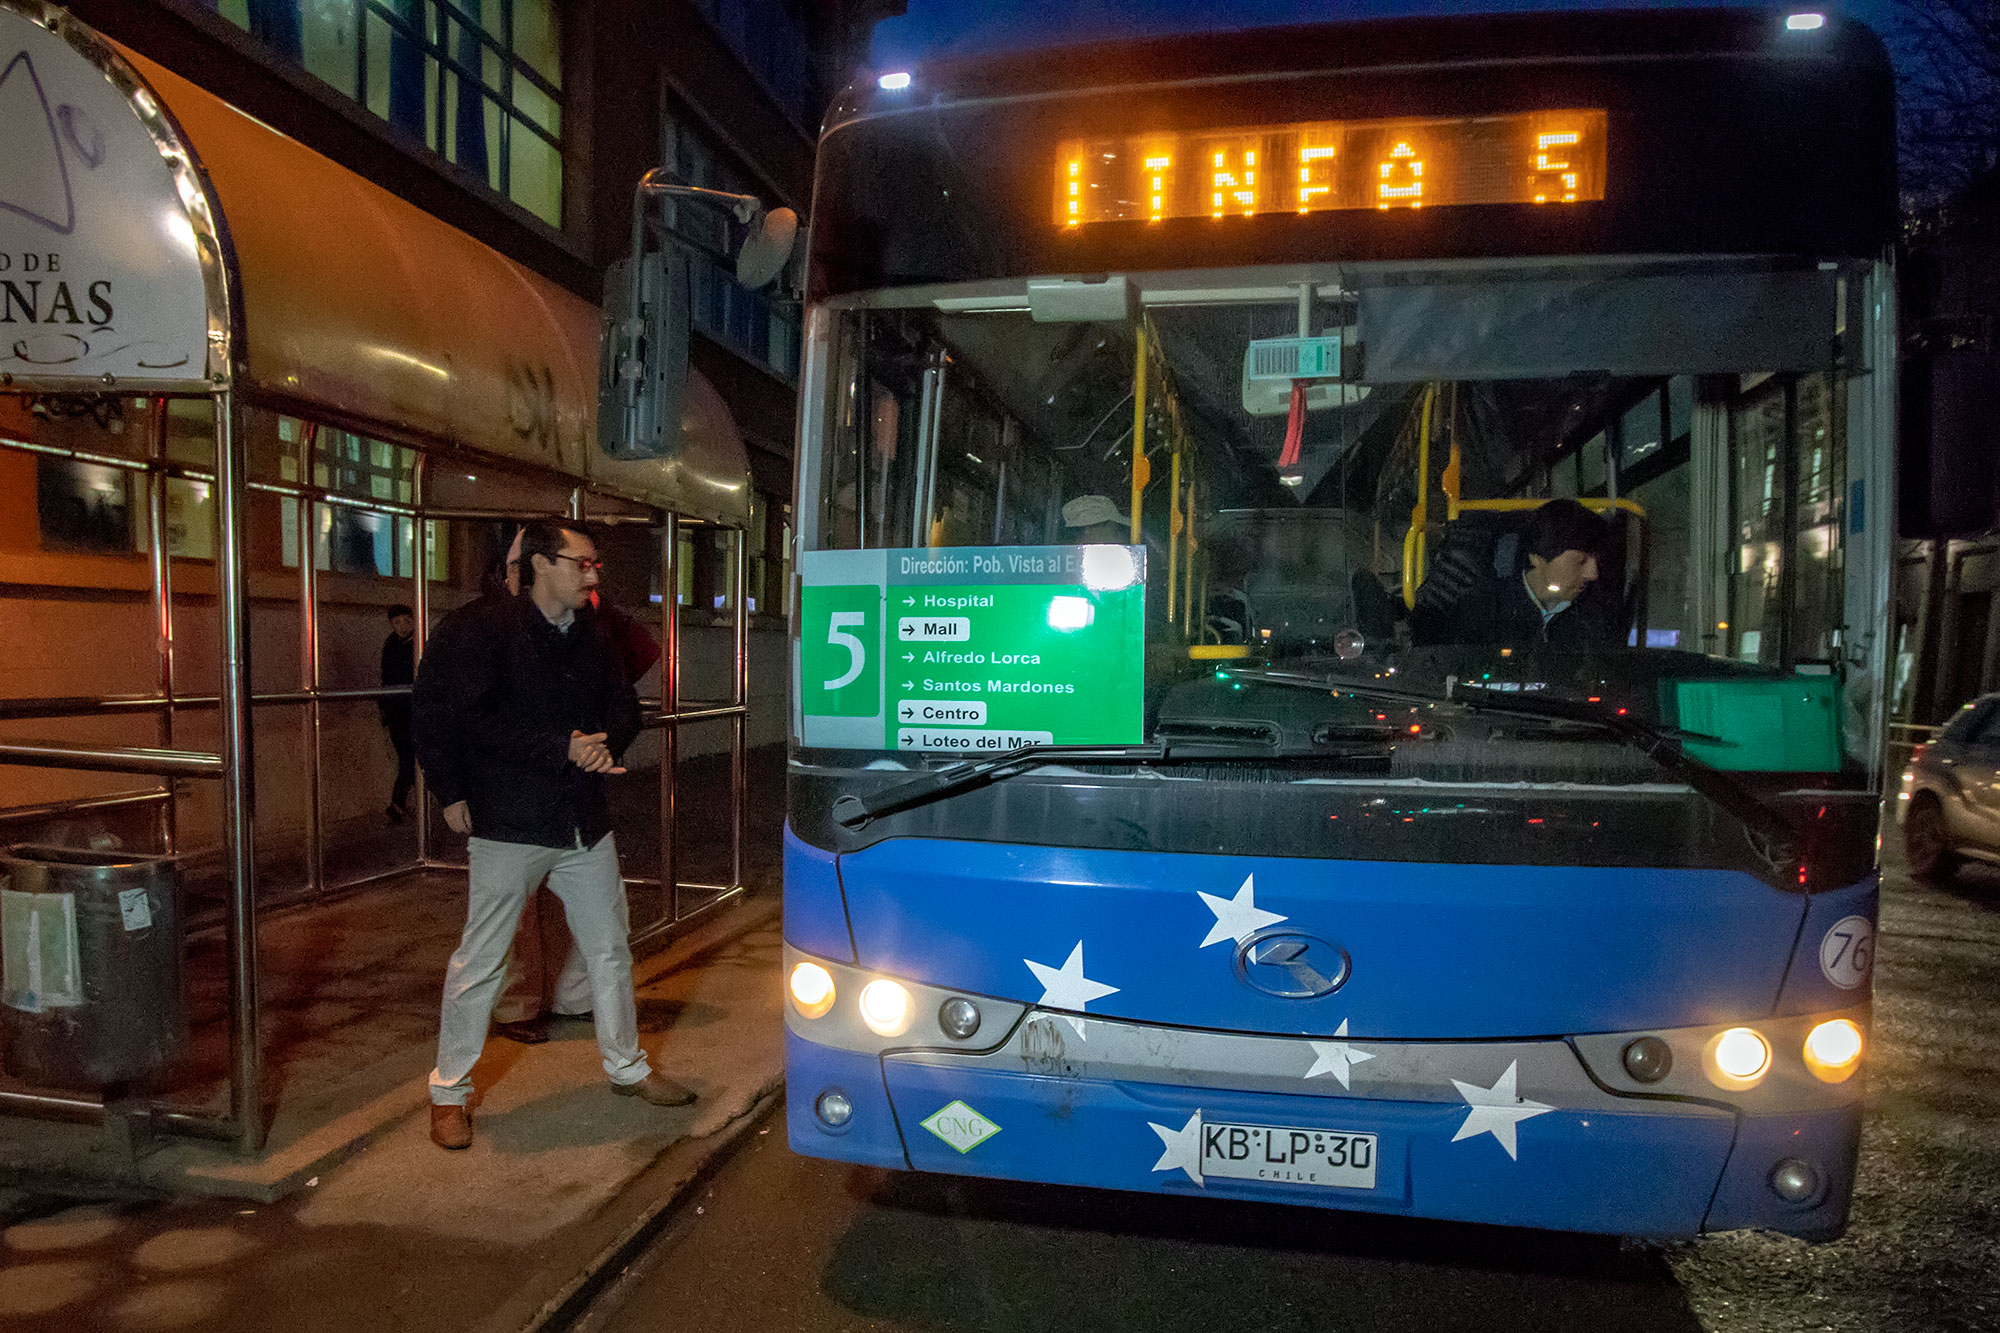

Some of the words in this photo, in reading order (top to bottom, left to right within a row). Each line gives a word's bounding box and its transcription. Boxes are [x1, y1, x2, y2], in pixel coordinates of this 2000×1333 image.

[1534, 132, 1580, 204] 5
[23, 252, 60, 273] DE
[0, 280, 114, 326] NAS
[900, 555, 969, 575] Dirección:
[973, 554, 1005, 574] Pob.
[1008, 554, 1045, 574] Vista
[1048, 554, 1061, 574] al
[924, 594, 994, 610] Hospital
[923, 622, 957, 636] Mall
[823, 611, 866, 691] 5
[922, 650, 985, 664] Alfredo
[991, 651, 1041, 665] Lorca
[922, 678, 982, 693] Santos
[987, 679, 1075, 694] Mardones
[922, 706, 980, 720] Centro
[922, 734, 970, 748] Loteo
[976, 735, 1001, 749] del
[1829, 931, 1871, 972] 76
[936, 1116, 983, 1137] CNG
[1258, 1169, 1317, 1182] CHILE
